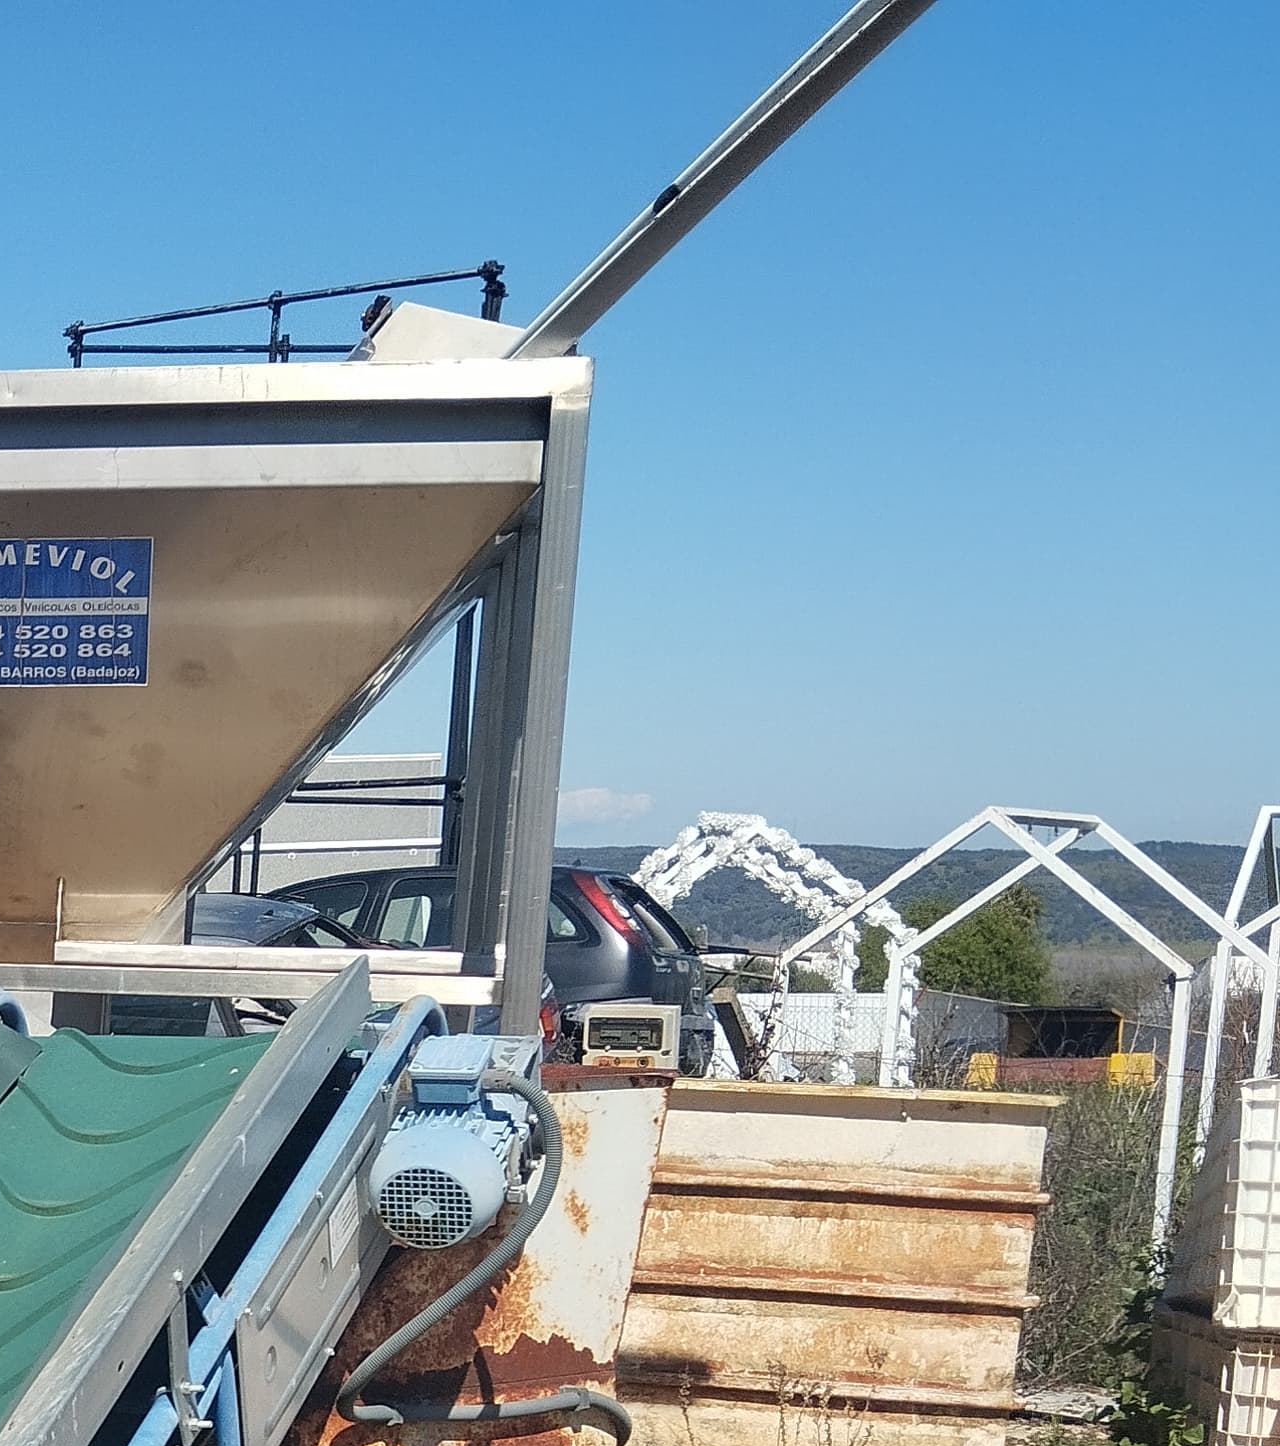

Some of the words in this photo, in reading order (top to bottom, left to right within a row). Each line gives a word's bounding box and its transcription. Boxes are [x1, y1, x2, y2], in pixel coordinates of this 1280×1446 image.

[15, 625, 69, 640] 520
[79, 624, 134, 639] 863
[13, 643, 67, 658] 520
[77, 643, 132, 658] 864
[0, 666, 67, 678] BARROS
[71, 665, 140, 681] (Badajoz)
